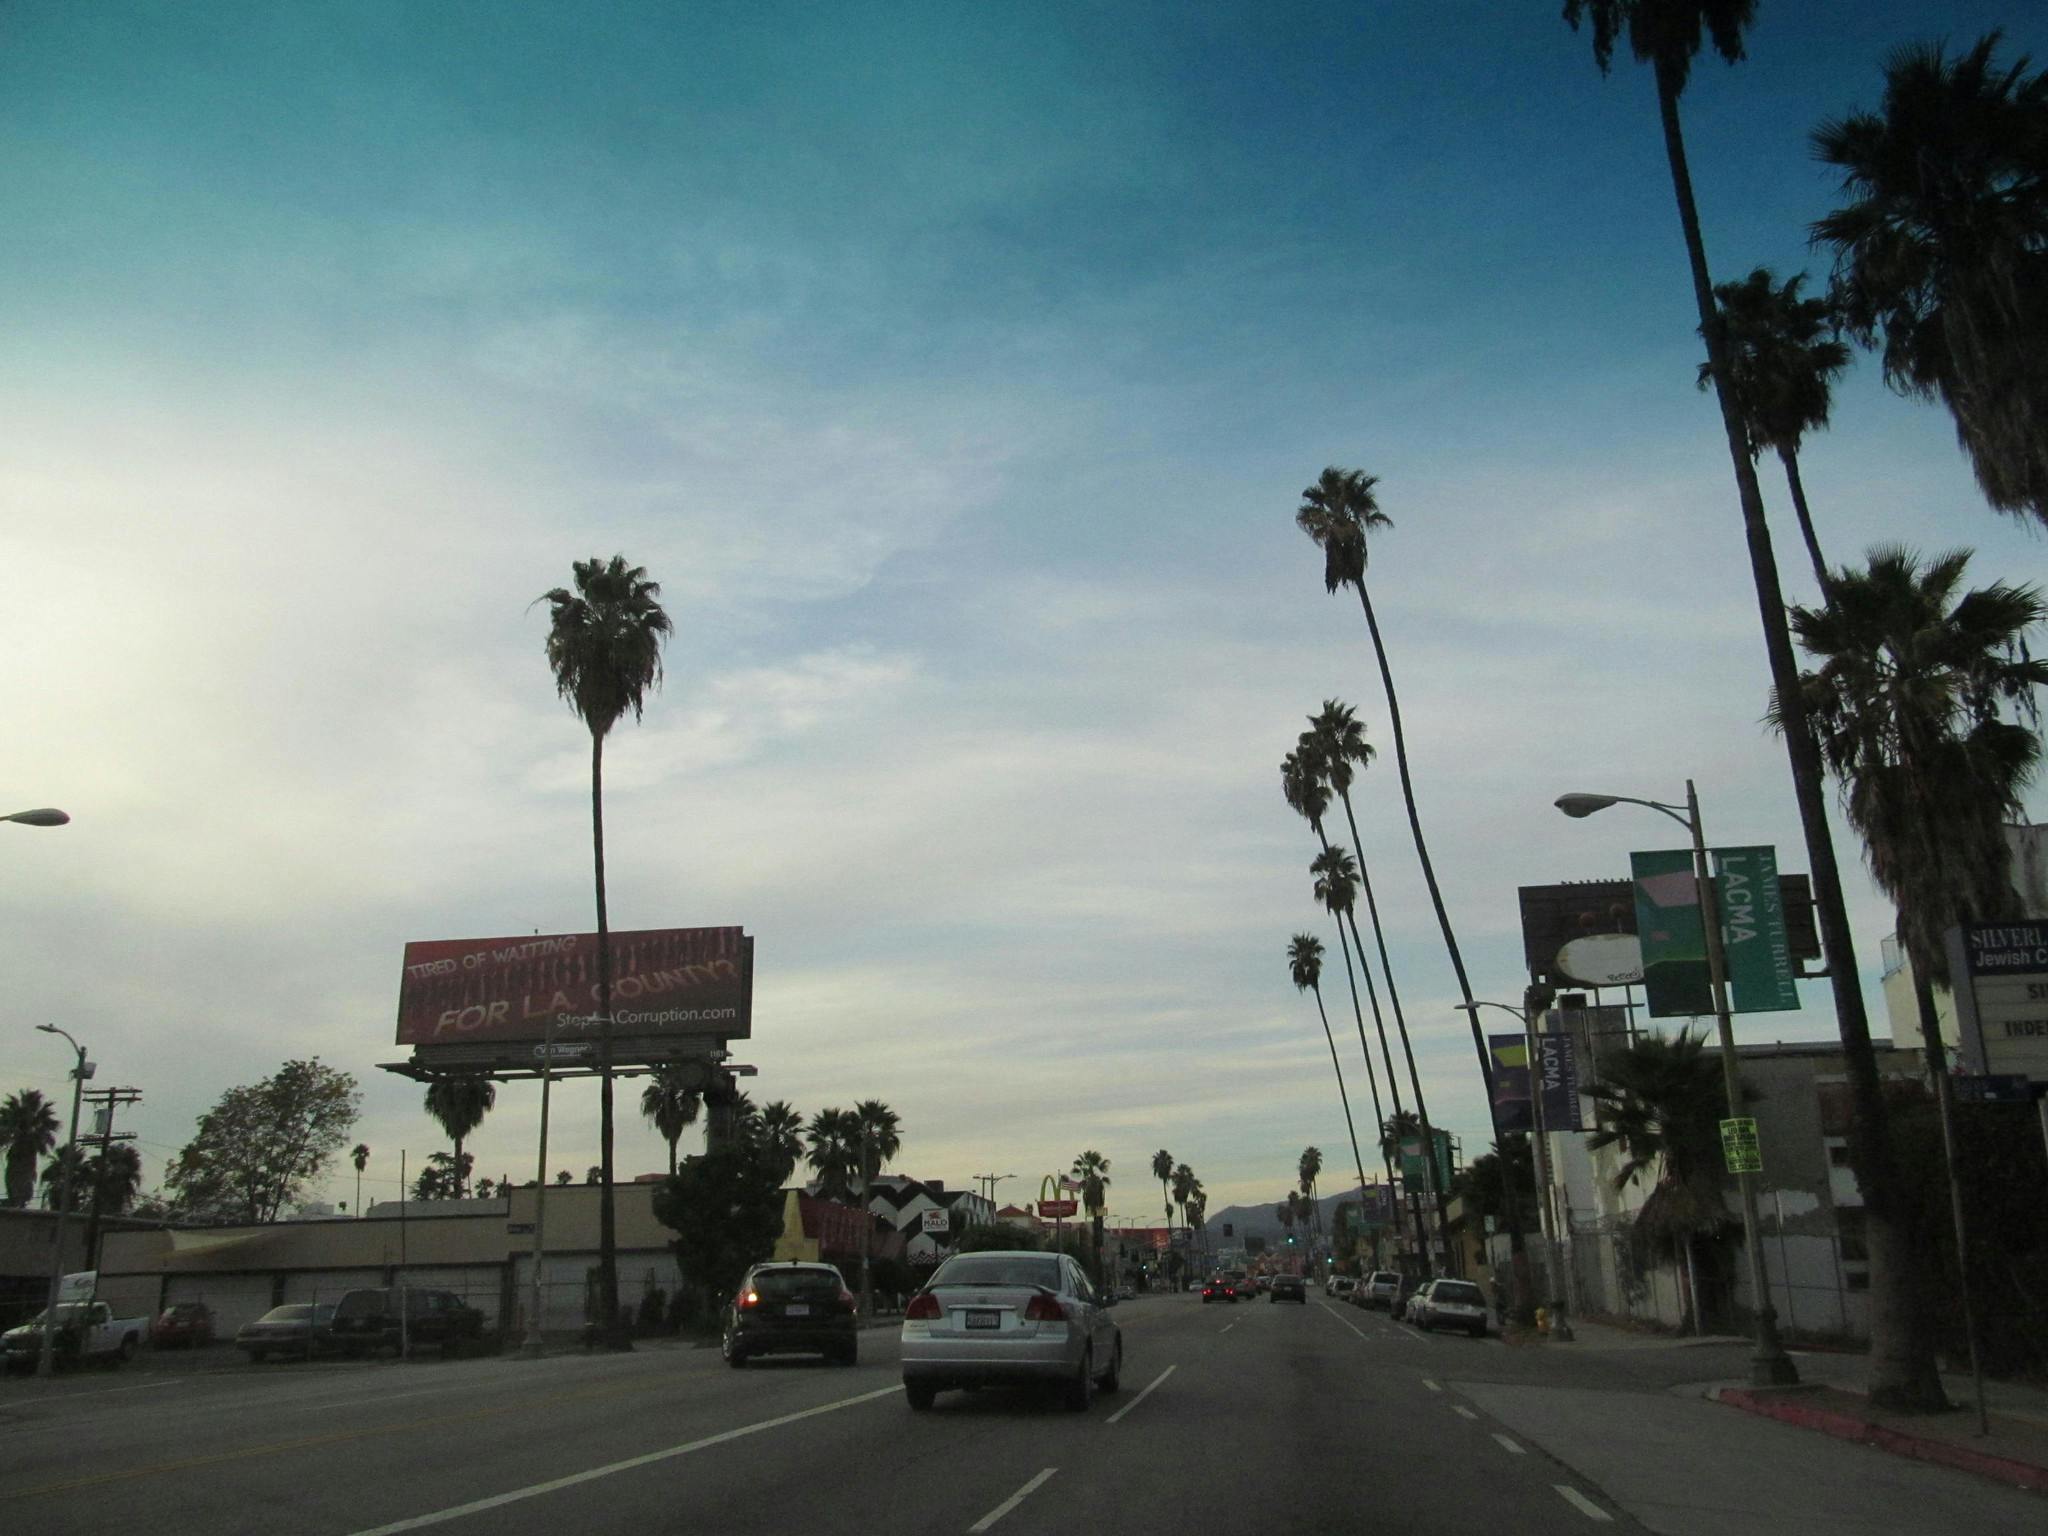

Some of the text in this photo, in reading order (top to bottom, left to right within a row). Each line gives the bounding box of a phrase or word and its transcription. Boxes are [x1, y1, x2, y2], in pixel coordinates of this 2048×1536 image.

[1720, 856, 1758, 945] LACMA
[407, 935, 578, 980] TIRED OF WAITING
[1975, 949, 2031, 967] Jewish
[2026, 984, 2048, 999] SI
[433, 1000, 510, 1037] FOR
[2005, 1018, 2048, 1036] INDE
[1542, 1038, 1561, 1090] LACMA
